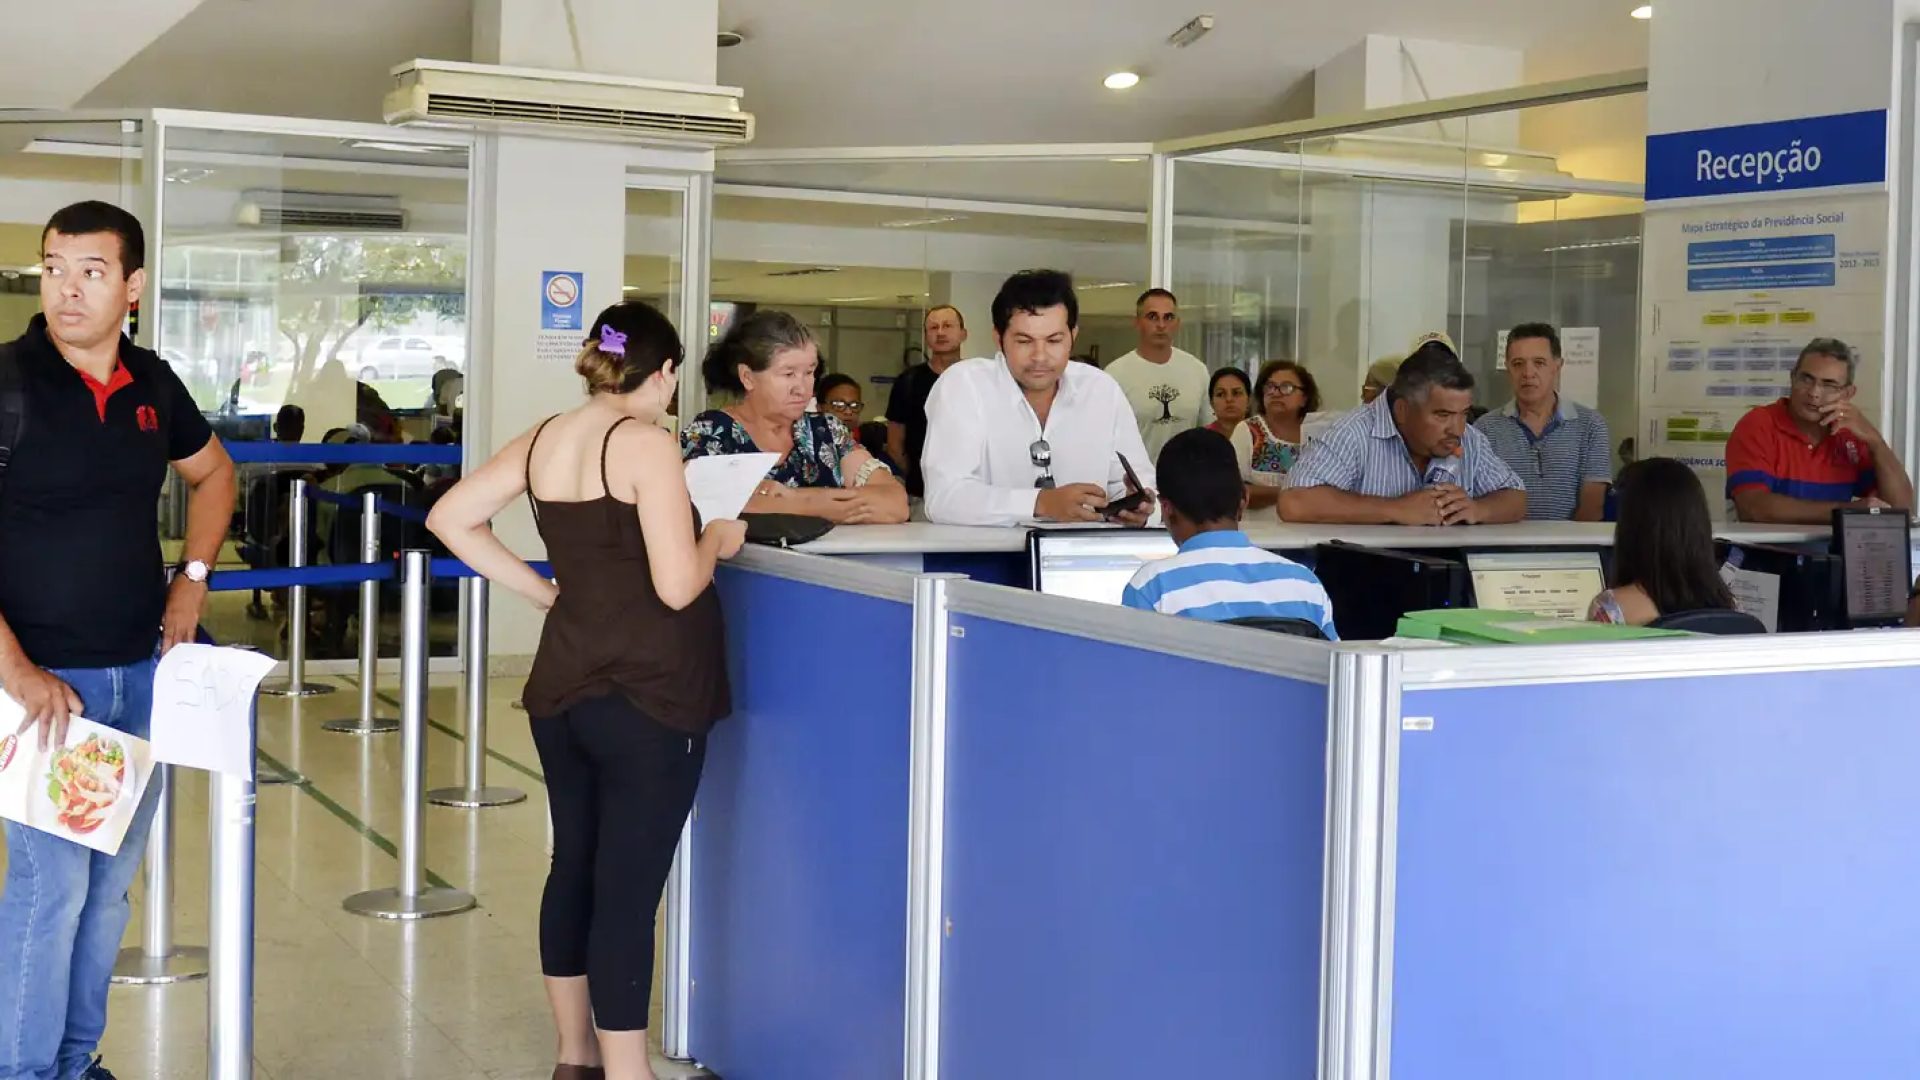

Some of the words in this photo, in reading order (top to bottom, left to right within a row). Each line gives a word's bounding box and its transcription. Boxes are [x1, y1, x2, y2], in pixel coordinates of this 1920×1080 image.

[1696, 139, 1821, 184] Recepção
[1682, 223, 1704, 234] Mapa
[1705, 219, 1749, 232] Estratégico
[1751, 217, 1762, 229] da
[1764, 213, 1814, 227] Previdência
[1817, 211, 1844, 224] Social
